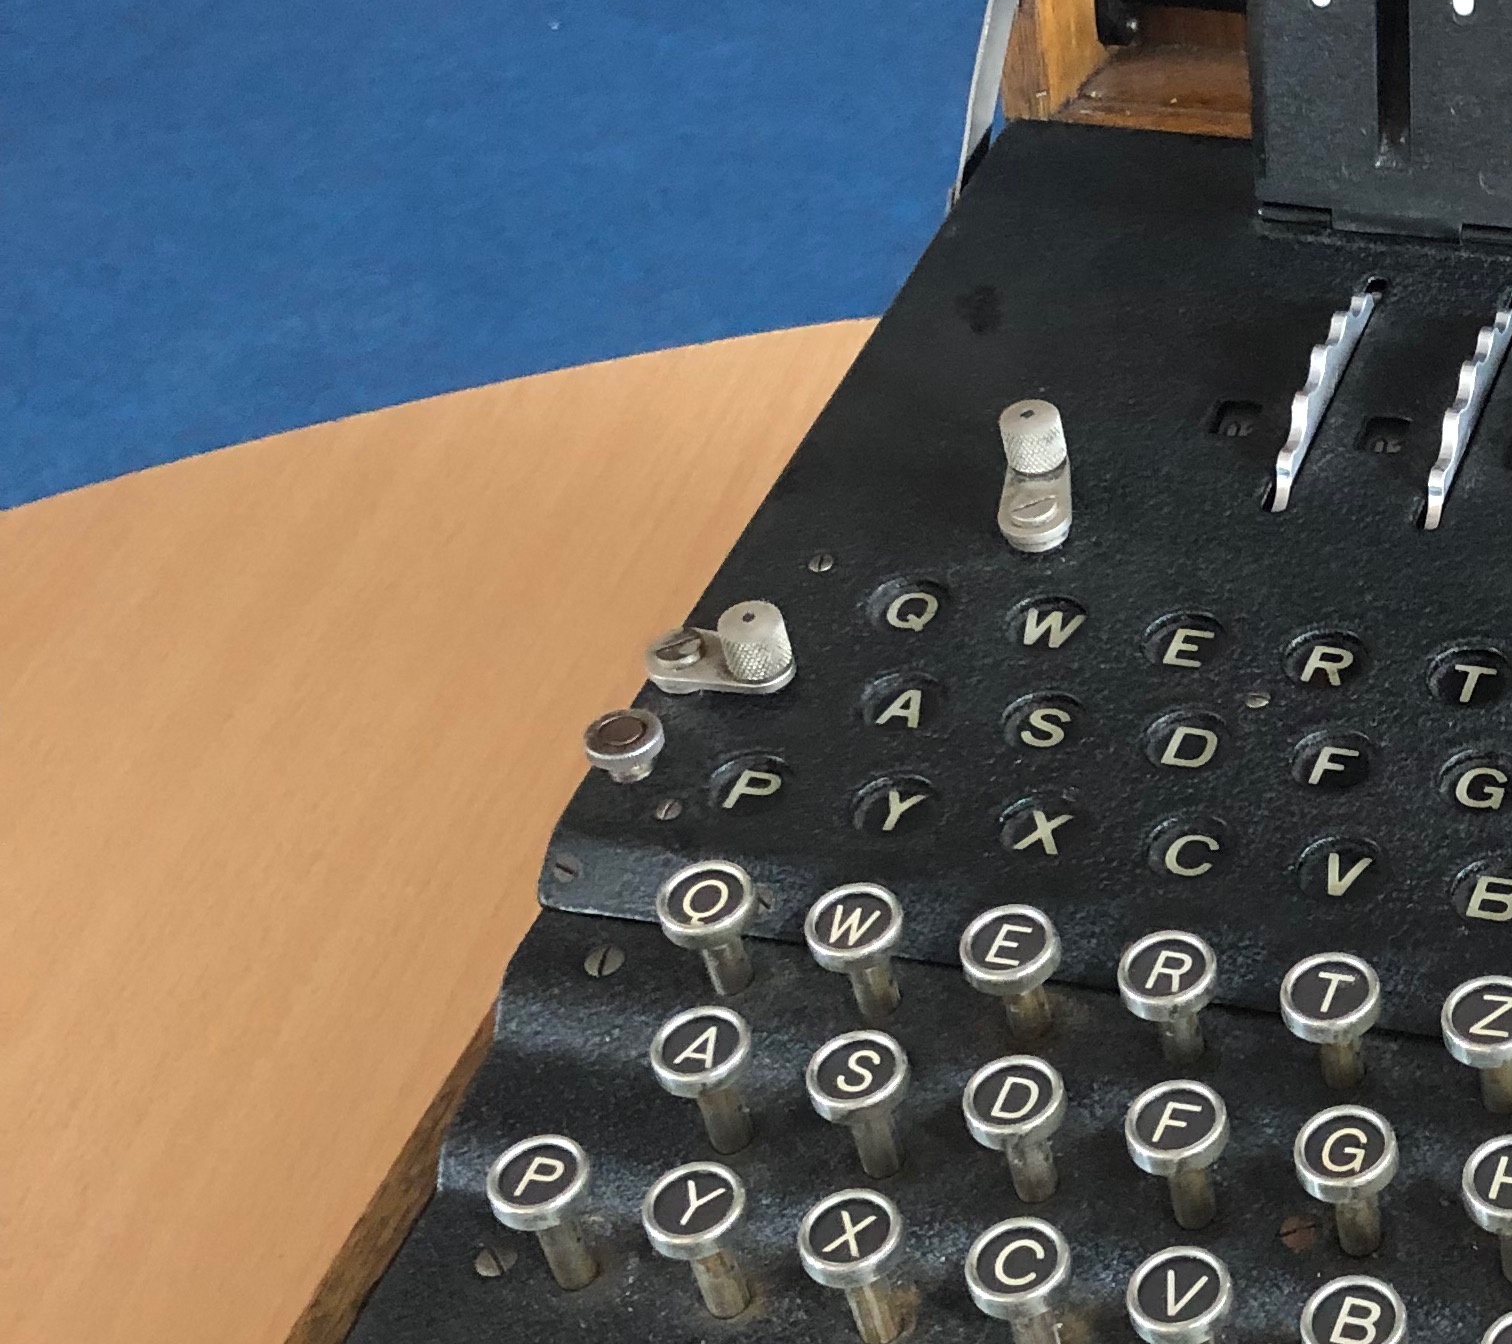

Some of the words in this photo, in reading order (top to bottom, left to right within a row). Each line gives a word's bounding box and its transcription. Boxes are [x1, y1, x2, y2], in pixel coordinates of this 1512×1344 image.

[886, 592, 939, 632] Q
[1023, 607, 1084, 648] W
[1162, 628, 1215, 668] E
[1300, 645, 1354, 686] R
[1454, 663, 1498, 703] T
[875, 689, 922, 729] A
[1020, 708, 1071, 748] S
[1160, 725, 1218, 768] D
[1308, 746, 1360, 785] F
[1455, 767, 1508, 809] G
[722, 768, 782, 809] P
[882, 788, 926, 831] Y
[1013, 809, 1073, 855] X
[1164, 834, 1220, 876] C
[1327, 852, 1373, 896] V
[681, 878, 730, 928] Q
[828, 904, 881, 946] W
[984, 923, 1033, 967] E
[1144, 950, 1193, 993] R
[1318, 971, 1356, 1013] T
[672, 1026, 718, 1069] A
[836, 1049, 880, 1093] S
[990, 1076, 1039, 1119] D
[1151, 1101, 1202, 1143] F
[1321, 1127, 1368, 1173] G
[513, 1156, 565, 1197] P
[679, 1179, 726, 1226] Y
[825, 1210, 877, 1258] X
[994, 1238, 1042, 1286] C
[1166, 1269, 1209, 1316] V
